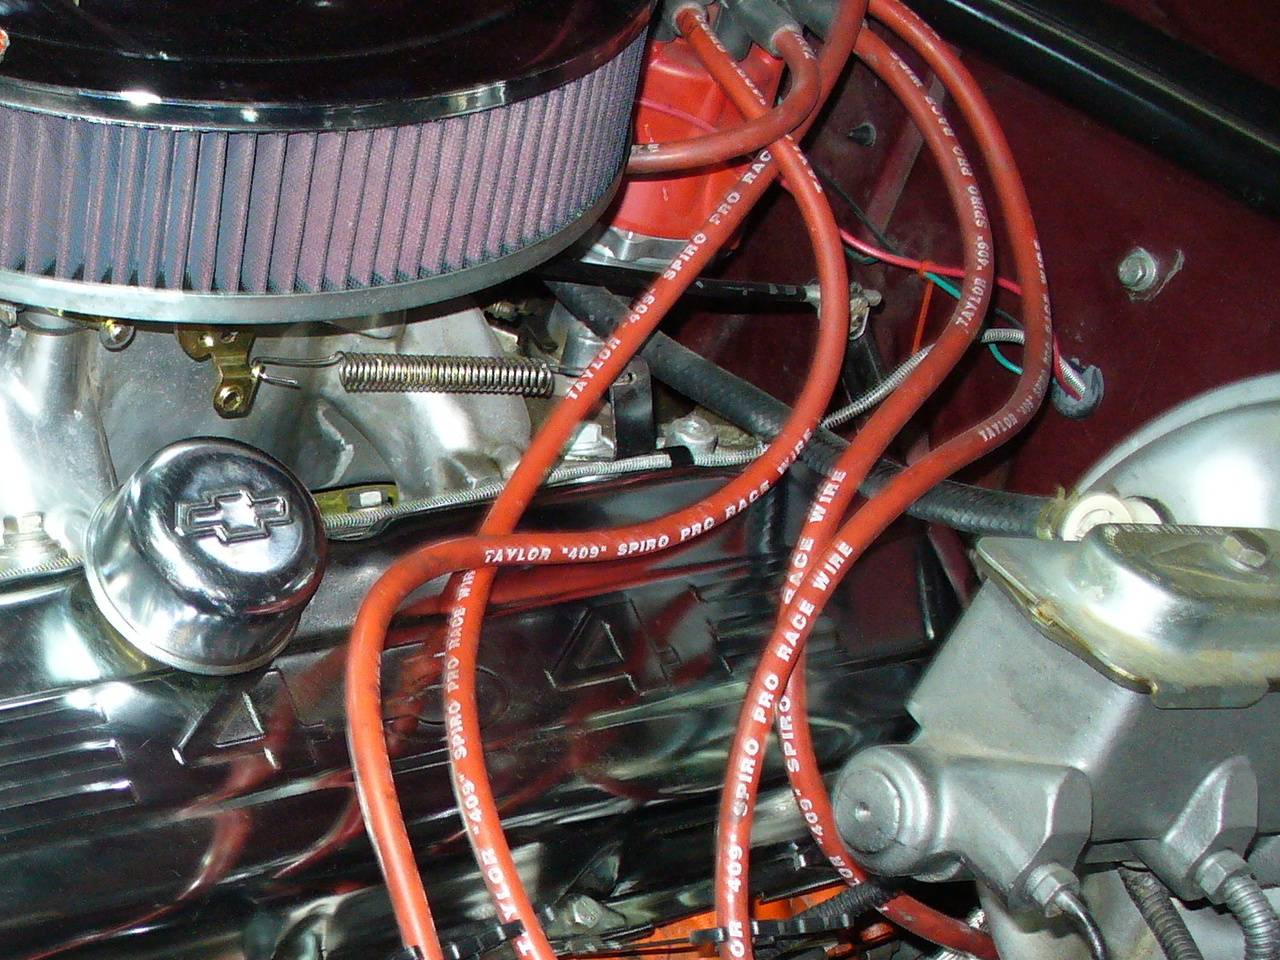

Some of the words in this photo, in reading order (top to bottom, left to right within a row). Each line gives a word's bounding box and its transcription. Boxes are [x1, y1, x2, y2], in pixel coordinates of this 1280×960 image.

[967, 184, 988, 230] SPIRO
[567, 337, 622, 401] TAYLOR
[662, 232, 707, 281] SPIRO
[708, 190, 742, 226] PRO
[956, 277, 988, 334] TAYLOR
[978, 412, 1019, 443] TAYLOR
[484, 547, 552, 565] TAYLOR
[562, 545, 608, 561] "409"
[616, 534, 671, 557] SPIRO
[680, 516, 716, 542] PRO
[725, 479, 771, 520] RACE
[781, 537, 815, 605] RACE
[809, 469, 848, 523] WIRE
[811, 541, 854, 592] WIRE
[447, 607, 467, 651] RACE
[775, 598, 816, 663] RACE
[446, 655, 461, 693] PRO
[751, 673, 780, 725] PRO
[447, 700, 468, 761] SPIRO
[775, 695, 801, 773] SPIRO
[457, 773, 483, 835] "409"
[732, 737, 761, 818] SPIRO
[726, 833, 744, 904] "409"
[480, 847, 535, 956] TYLOR
